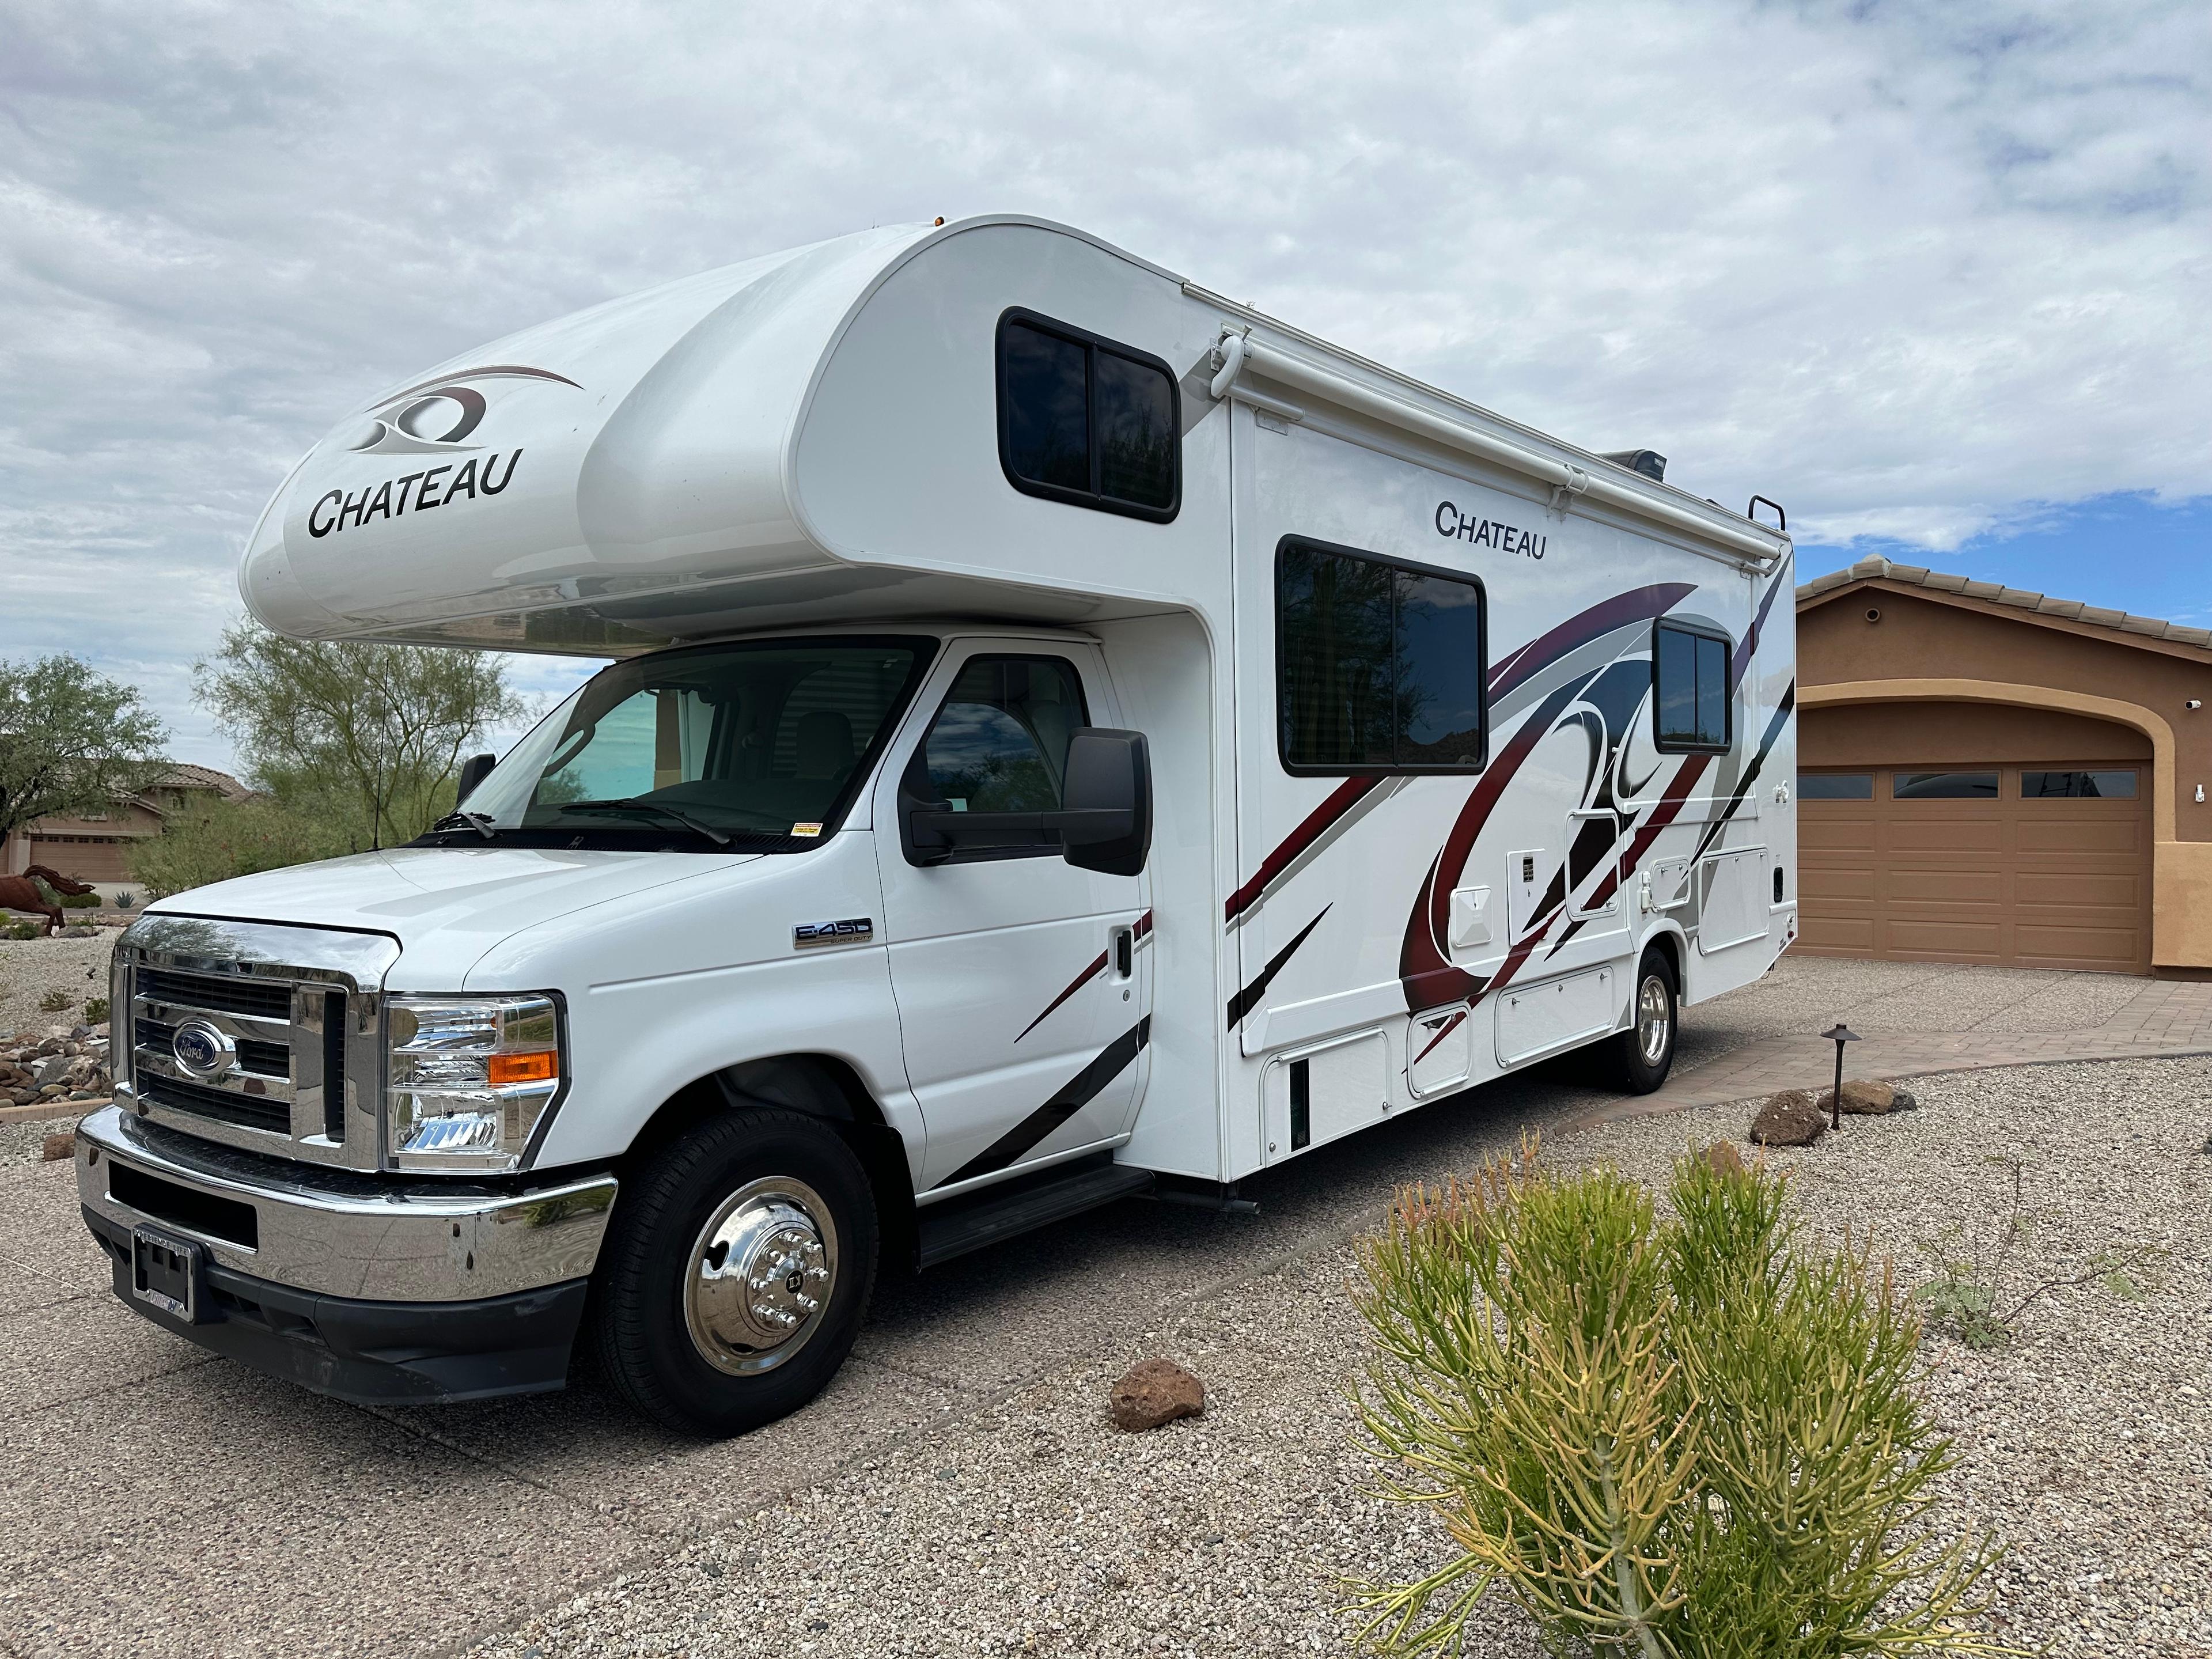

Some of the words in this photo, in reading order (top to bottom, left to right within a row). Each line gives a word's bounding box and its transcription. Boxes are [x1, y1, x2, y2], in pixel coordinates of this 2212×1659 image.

[308, 448, 524, 537] CHATEAU
[1435, 501, 1547, 560] CHATEAU
[180, 1035, 204, 1060] Ford
[173, 1244, 188, 1255] LIFE
